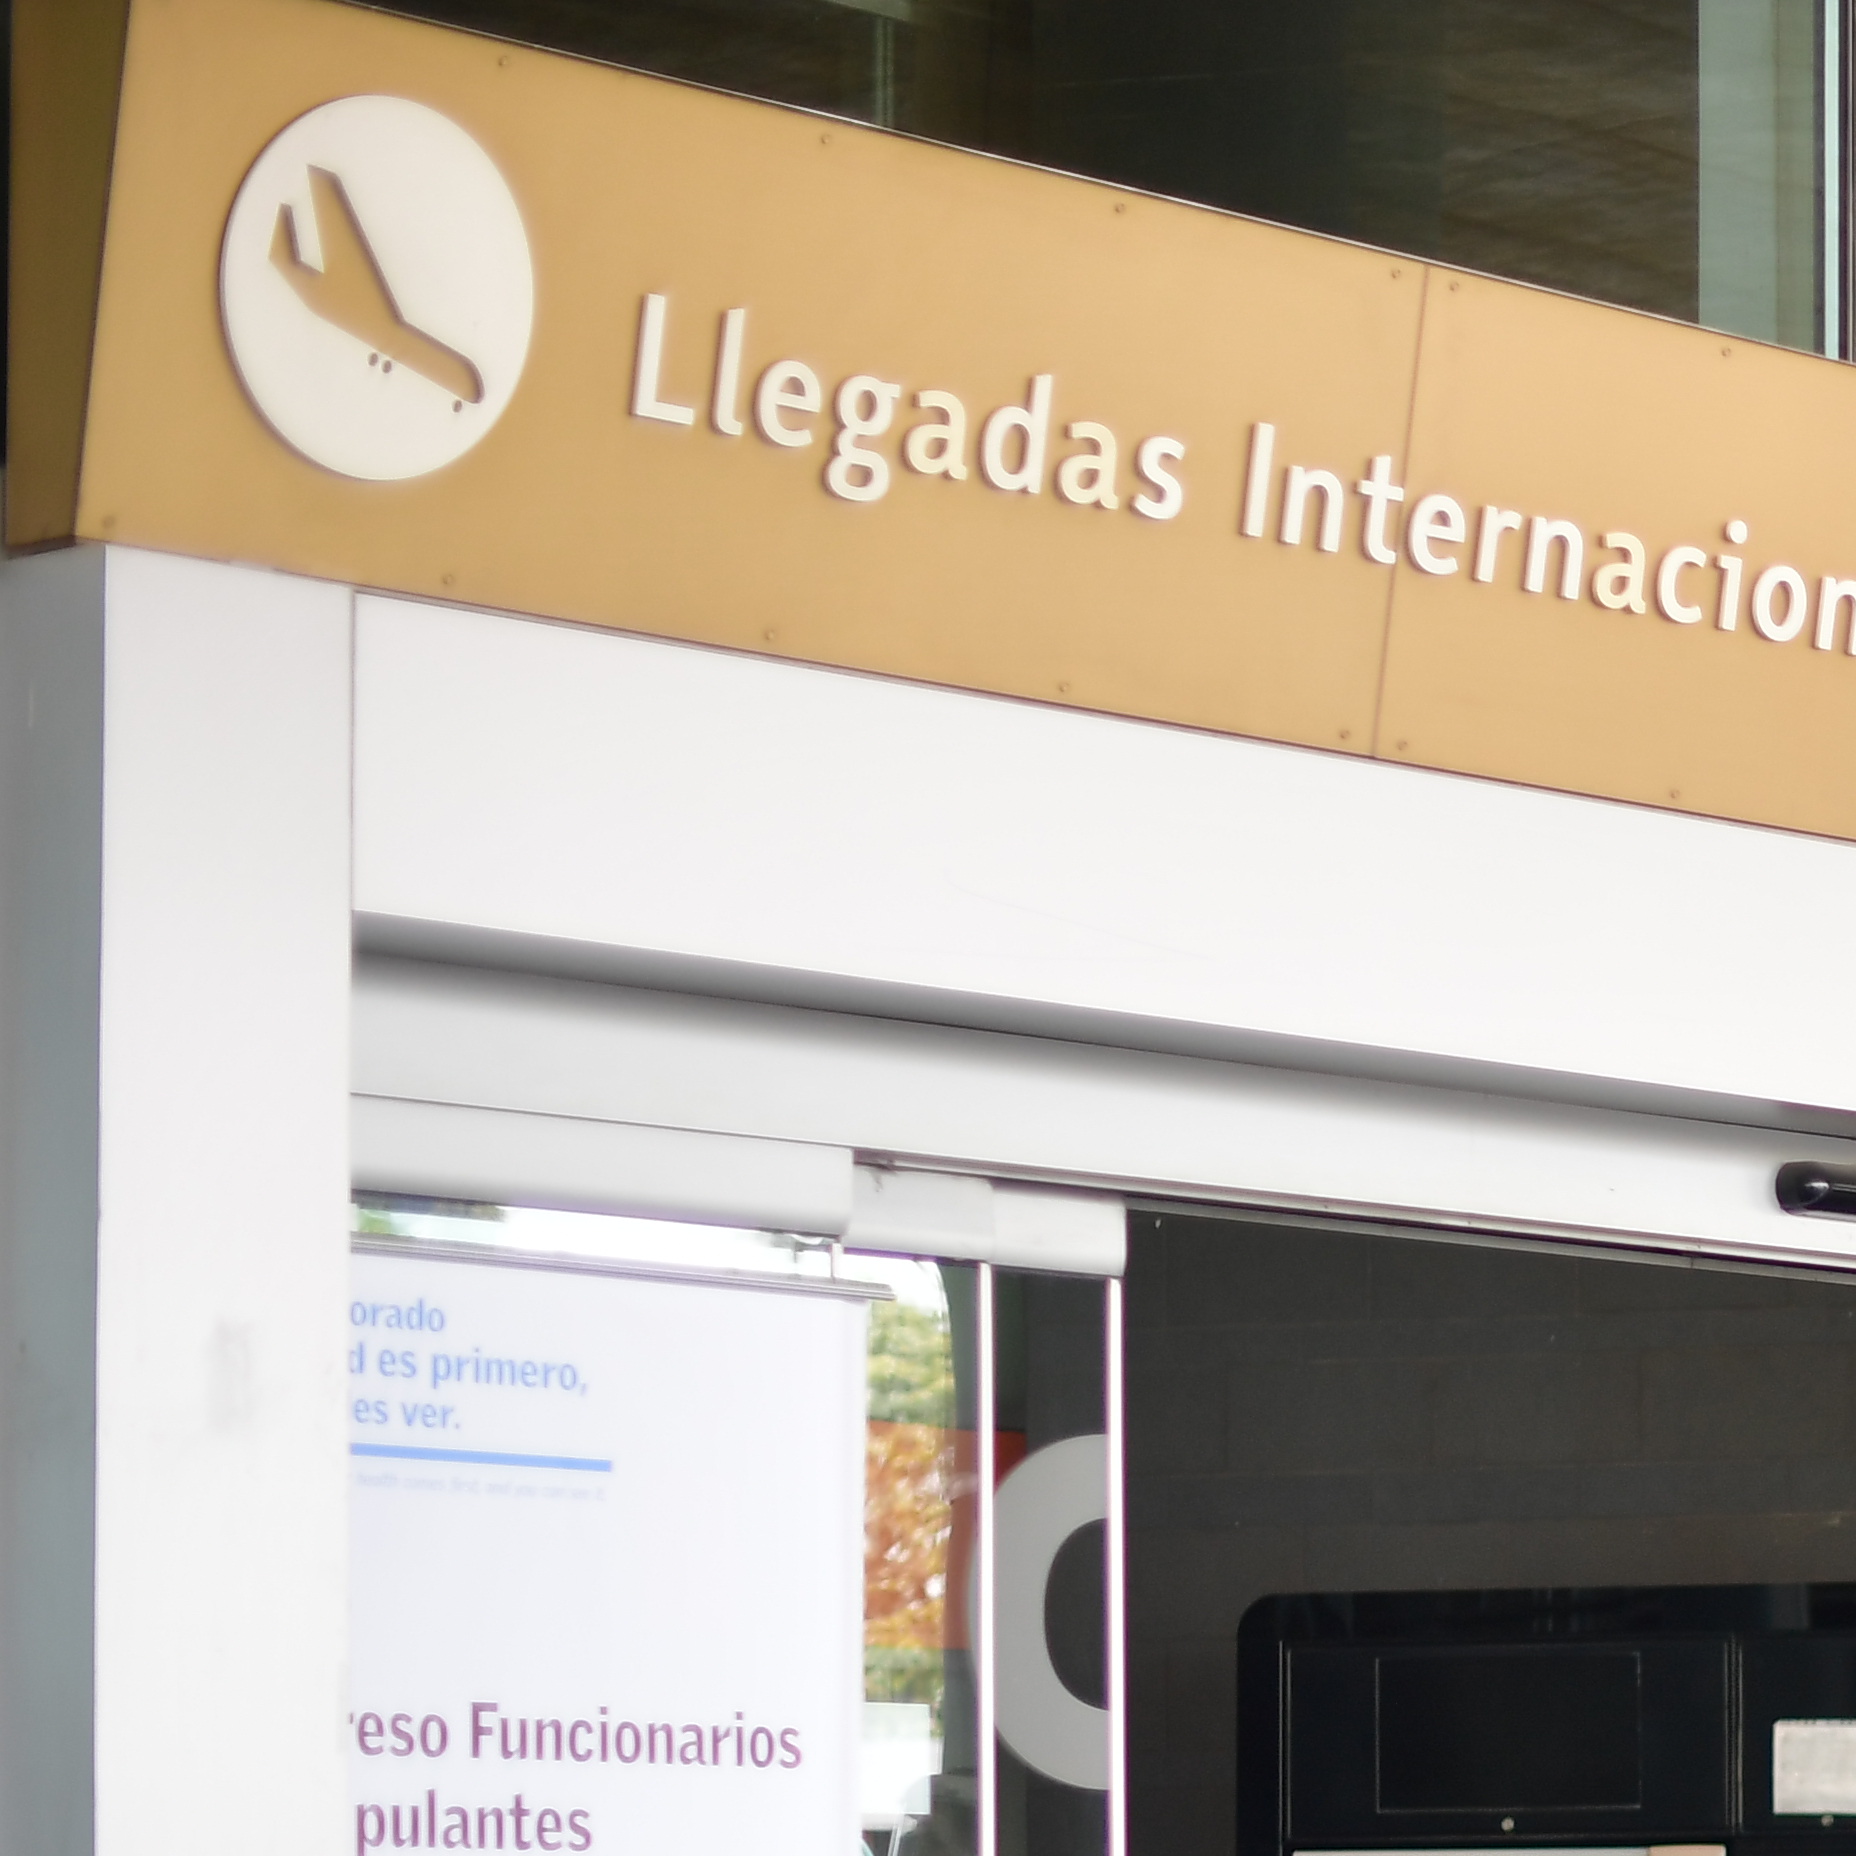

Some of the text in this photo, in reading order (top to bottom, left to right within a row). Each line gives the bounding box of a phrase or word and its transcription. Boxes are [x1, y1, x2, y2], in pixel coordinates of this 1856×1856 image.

[633, 292, 1184, 502] Llegadas
[350, 1299, 445, 1332] orado
[378, 1349, 417, 1378] es
[432, 1346, 587, 1396] primero,
[401, 1401, 460, 1430] ver.
[349, 1702, 802, 1769] eso Funcionarios
